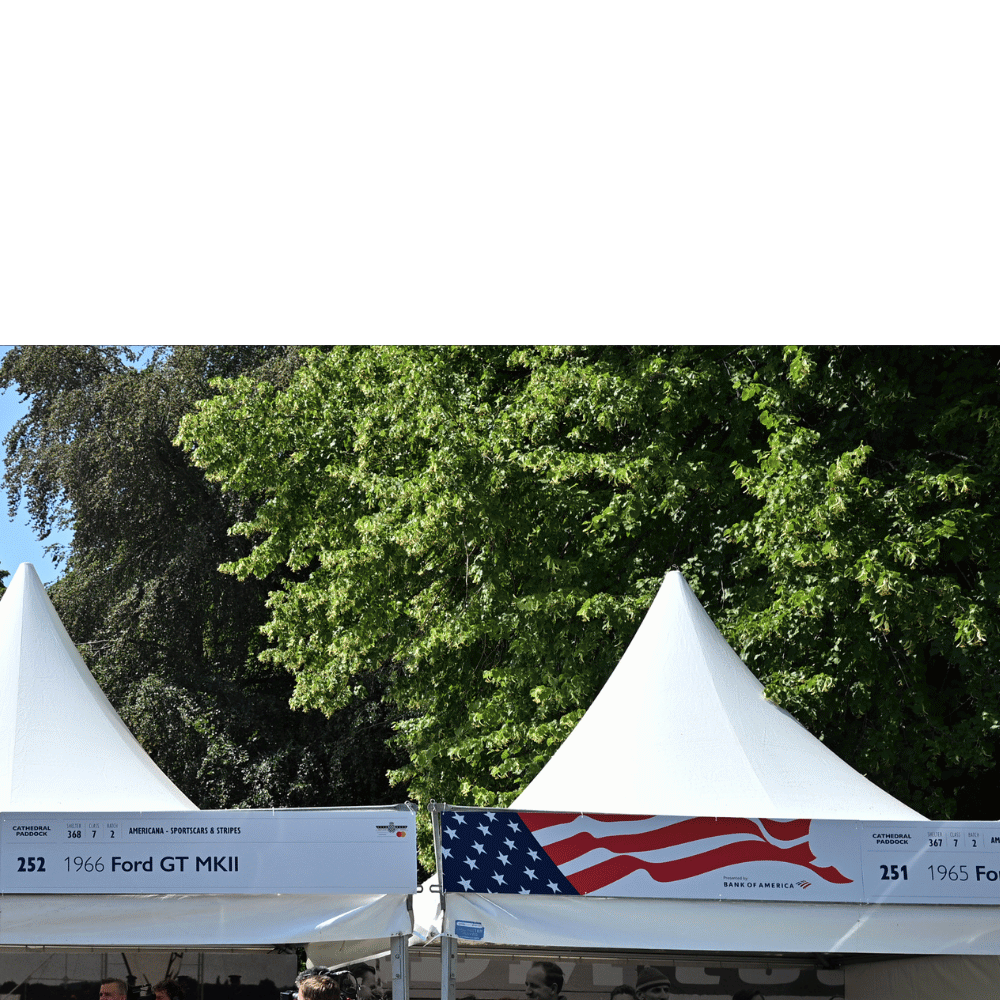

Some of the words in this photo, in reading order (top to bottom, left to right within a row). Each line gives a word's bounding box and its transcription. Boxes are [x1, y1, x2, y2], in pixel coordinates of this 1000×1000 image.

[67, 830, 82, 839] 368
[91, 830, 97, 839] 7
[110, 830, 115, 839] 2
[128, 827, 164, 835] AMERICANA
[170, 827, 208, 835] SPORTSCARS
[209, 827, 215, 835] &
[216, 827, 241, 835] STRIPES
[928, 838, 943, 847] 367
[953, 839, 959, 848] 7
[971, 839, 977, 848] 2
[17, 856, 46, 872] 252
[64, 855, 105, 873] 1966
[111, 856, 153, 872] Ford
[159, 856, 189, 872] GT
[195, 856, 239, 872] MKII
[879, 864, 908, 881] 251
[927, 864, 969, 881] 1965
[975, 865, 1000, 882] Fo
